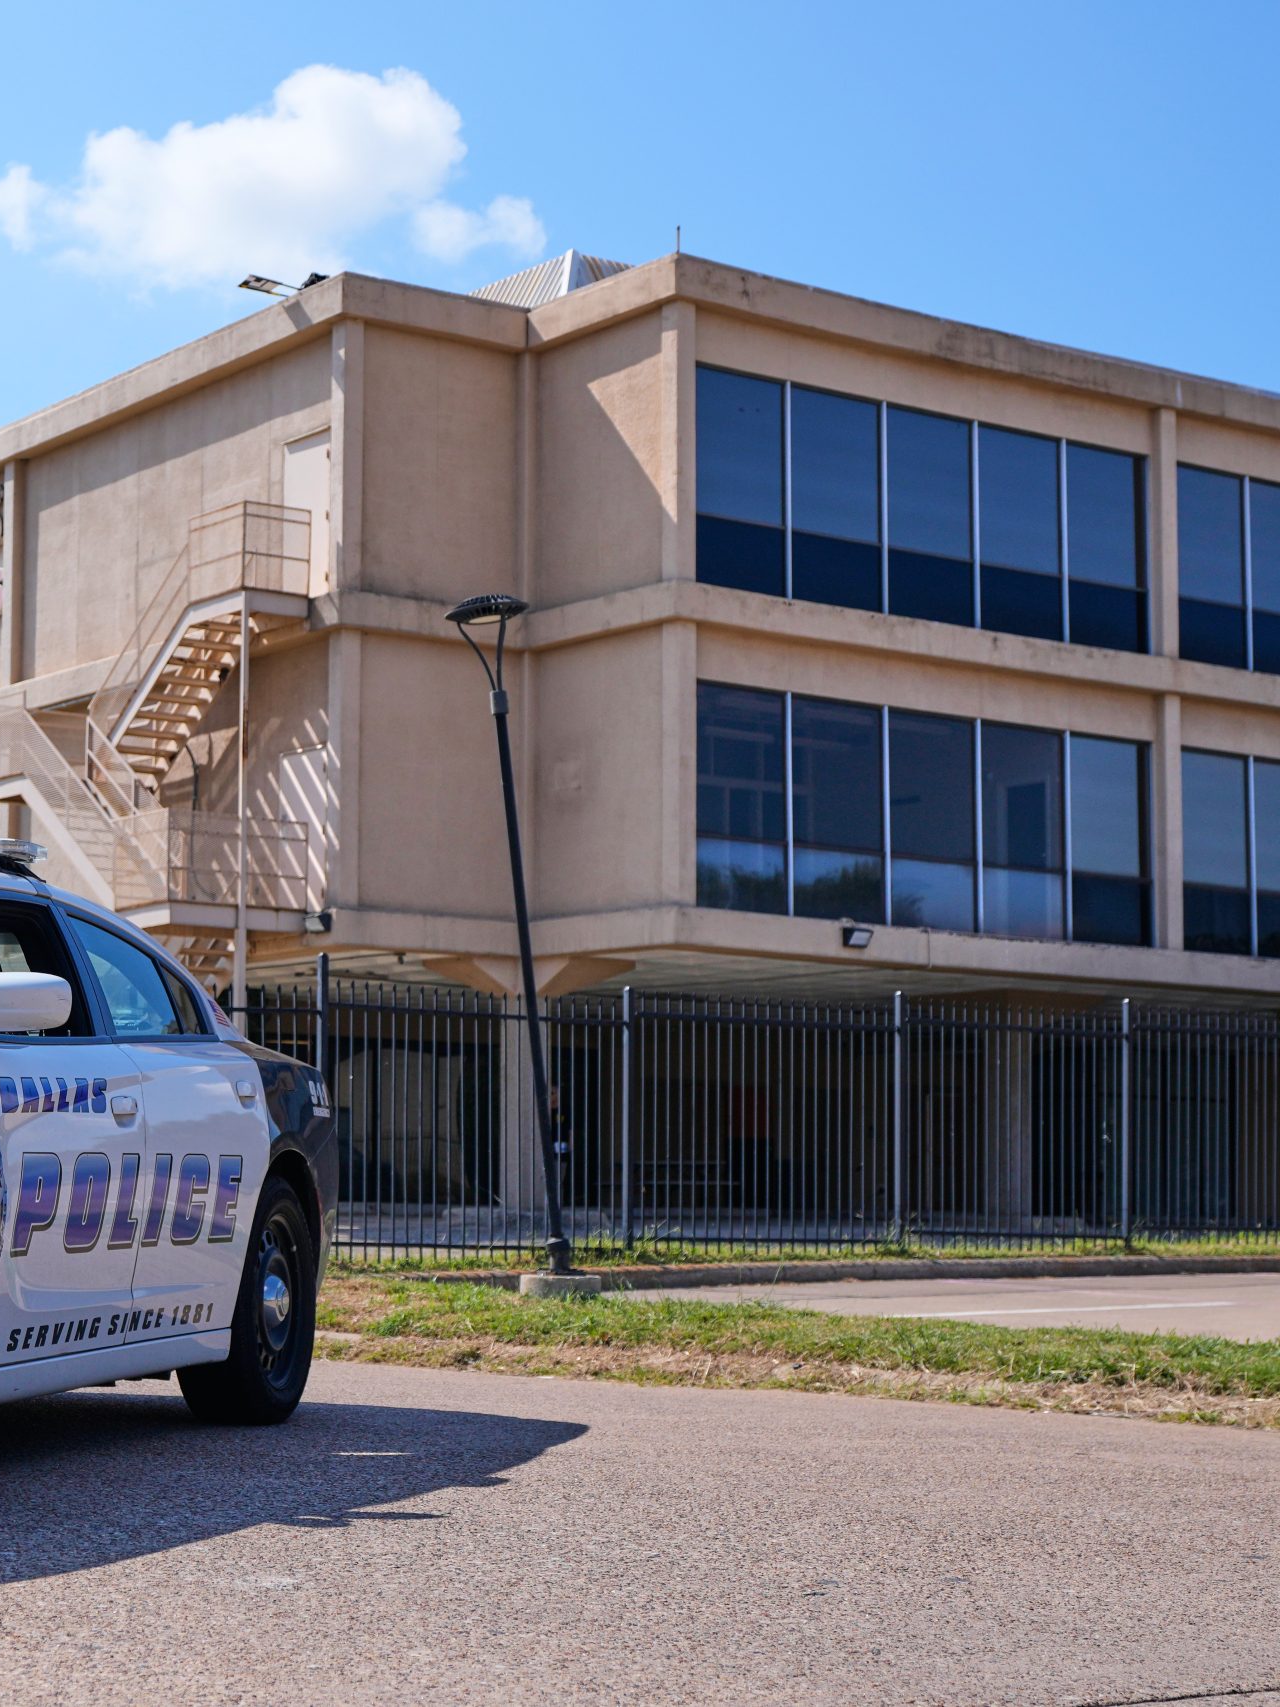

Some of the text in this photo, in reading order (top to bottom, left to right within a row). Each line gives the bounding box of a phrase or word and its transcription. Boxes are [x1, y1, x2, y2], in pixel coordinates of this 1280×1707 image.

[10, 1151, 244, 1257] POLICE
[6, 1302, 214, 1352] SERVING SINCE 1881
